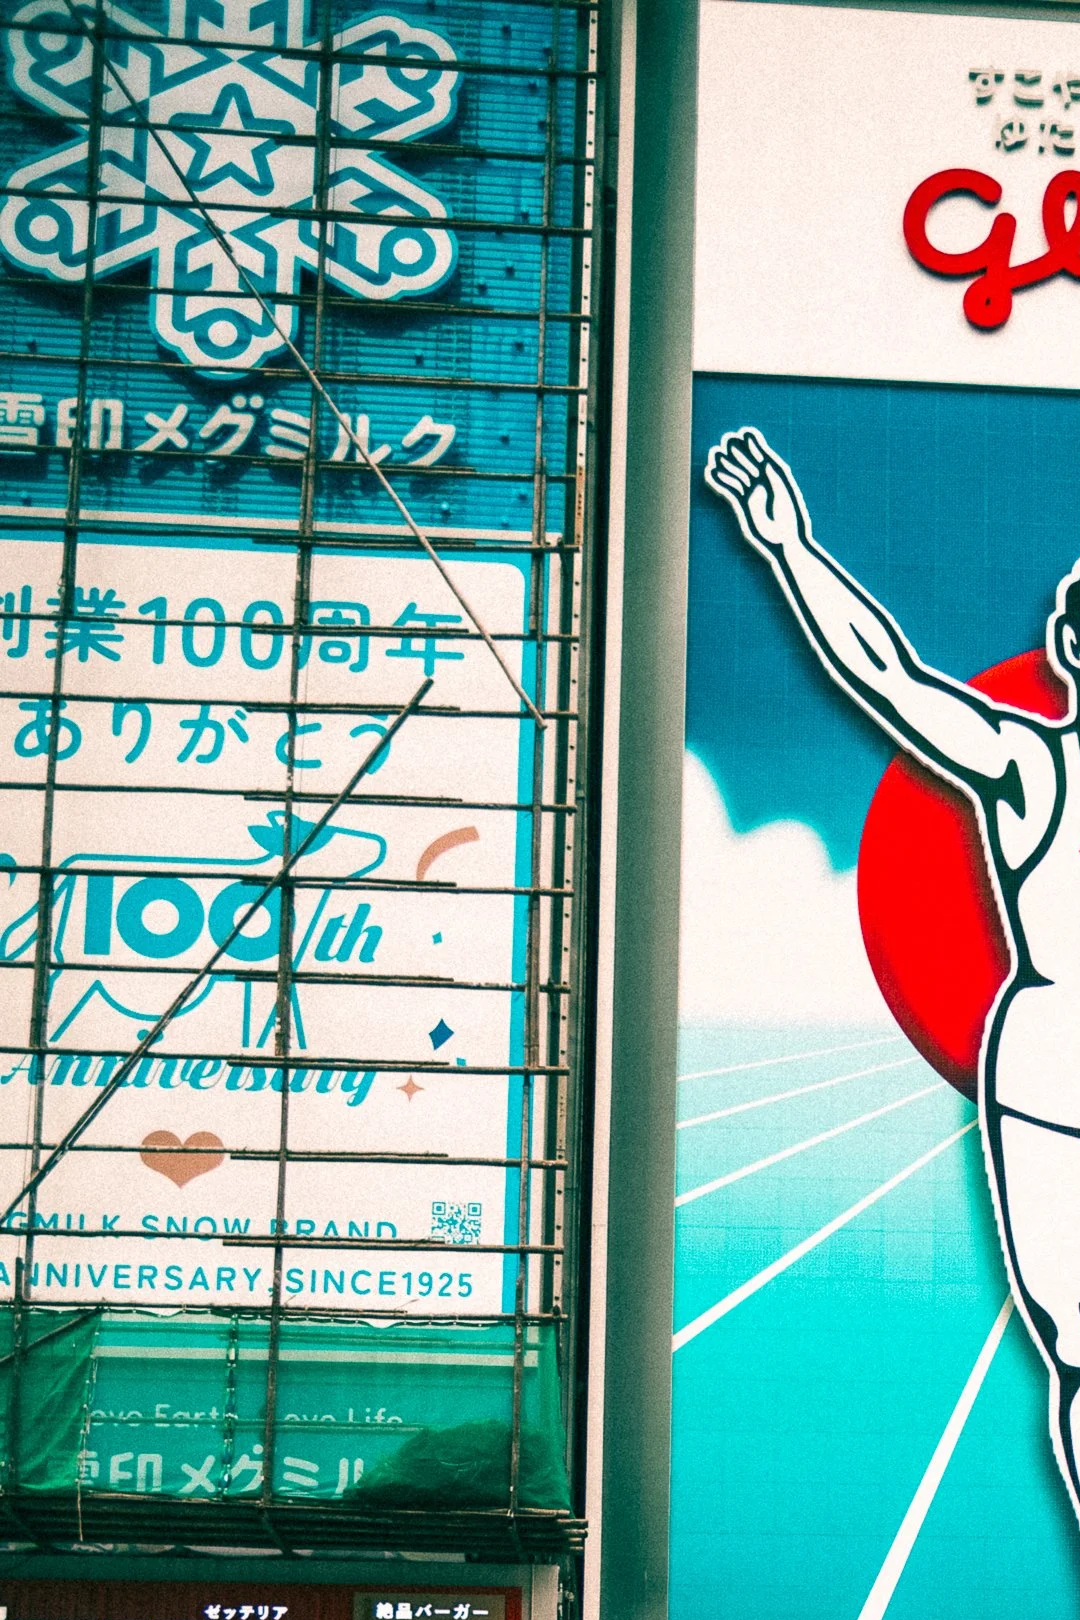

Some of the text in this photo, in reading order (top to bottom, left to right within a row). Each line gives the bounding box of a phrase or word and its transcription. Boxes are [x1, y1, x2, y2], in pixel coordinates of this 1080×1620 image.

[203, 1604, 289, 1620] ゼッテリア
[376, 1601, 490, 1620] 絶品バーガー
